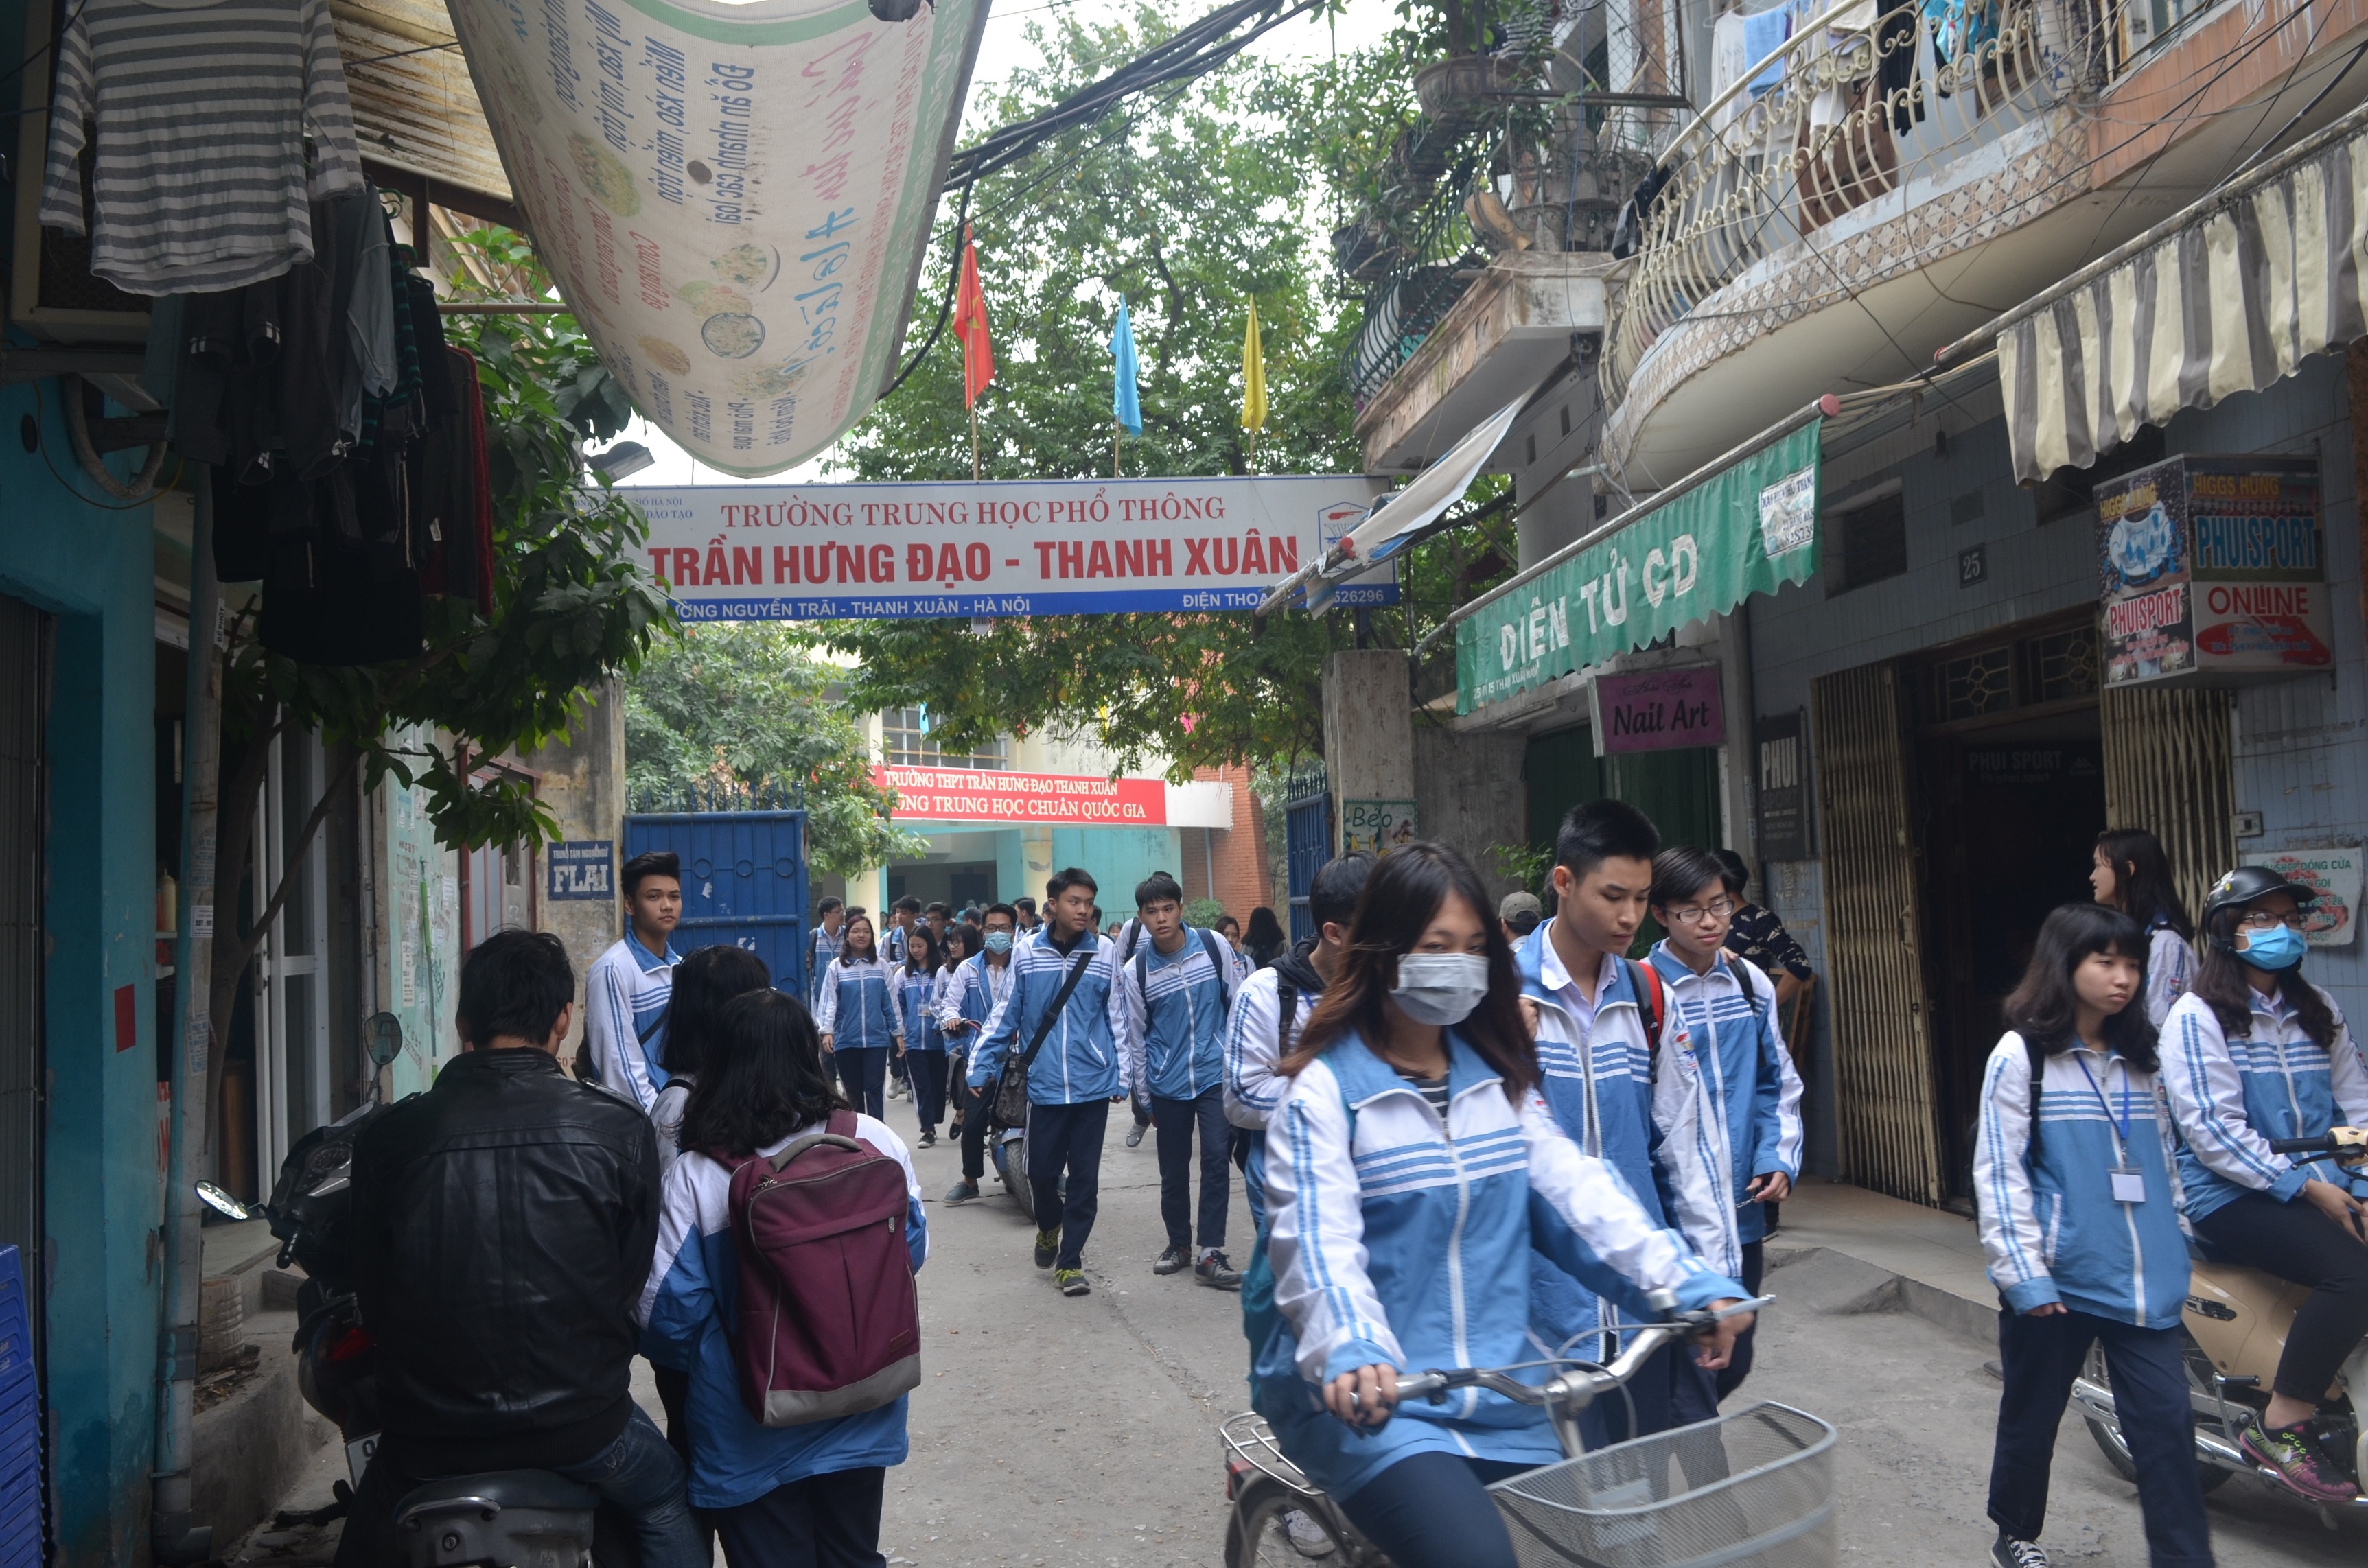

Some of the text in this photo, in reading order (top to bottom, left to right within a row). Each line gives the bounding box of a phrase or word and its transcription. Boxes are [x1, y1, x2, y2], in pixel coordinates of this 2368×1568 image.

[2193, 475, 2279, 496] HIGGS HUNG
[646, 508, 693, 520] ĐÀO TẠO
[651, 496, 663, 506] HÀ
[666, 496, 682, 507] NỘI
[721, 487, 1226, 529] TRƯỜNG TRUNG HỌC PHỔ THÔNG
[2197, 515, 2316, 569] PHUISPORT
[648, 534, 763, 587] TRẦN
[774, 541, 894, 584] HƯNG
[906, 542, 990, 589] ĐẠO
[1034, 539, 1172, 580] THANH
[1185, 528, 1299, 576] XUÂN
[1963, 552, 1981, 580] 25
[1581, 548, 1629, 635] TỬ
[1643, 533, 1697, 608] CD
[723, 598, 793, 618] NGUYỄN
[797, 598, 835, 616] TRÃI
[852, 602, 908, 616] THANH
[914, 597, 959, 614] XUÂN
[974, 596, 997, 613] HÀ
[1001, 596, 1030, 616] NỘI
[1183, 591, 1220, 610] ĐIỆN
[2110, 588, 2181, 638] PHUISPORT
[2207, 586, 2309, 615] ONLINE
[1614, 699, 1709, 736] Nail Art
[1761, 736, 1798, 791] PHUI
[1969, 751, 2062, 771] PHUI SPORT
[884, 769, 1117, 795] TRƯỜNG THPT TRẦN HƯNG ĐẠO THANH XUÂN
[933, 796, 1146, 819] TRUNG HỌC CHUẨN QUỐC GIA
[1762, 790, 1798, 810] SPORT
[1352, 806, 1393, 828] Béo
[2275, 862, 2298, 872] SHOP
[2301, 859, 2328, 870] ĐÓNG
[2332, 856, 2352, 869] CỬA
[554, 865, 609, 892] FLAI
